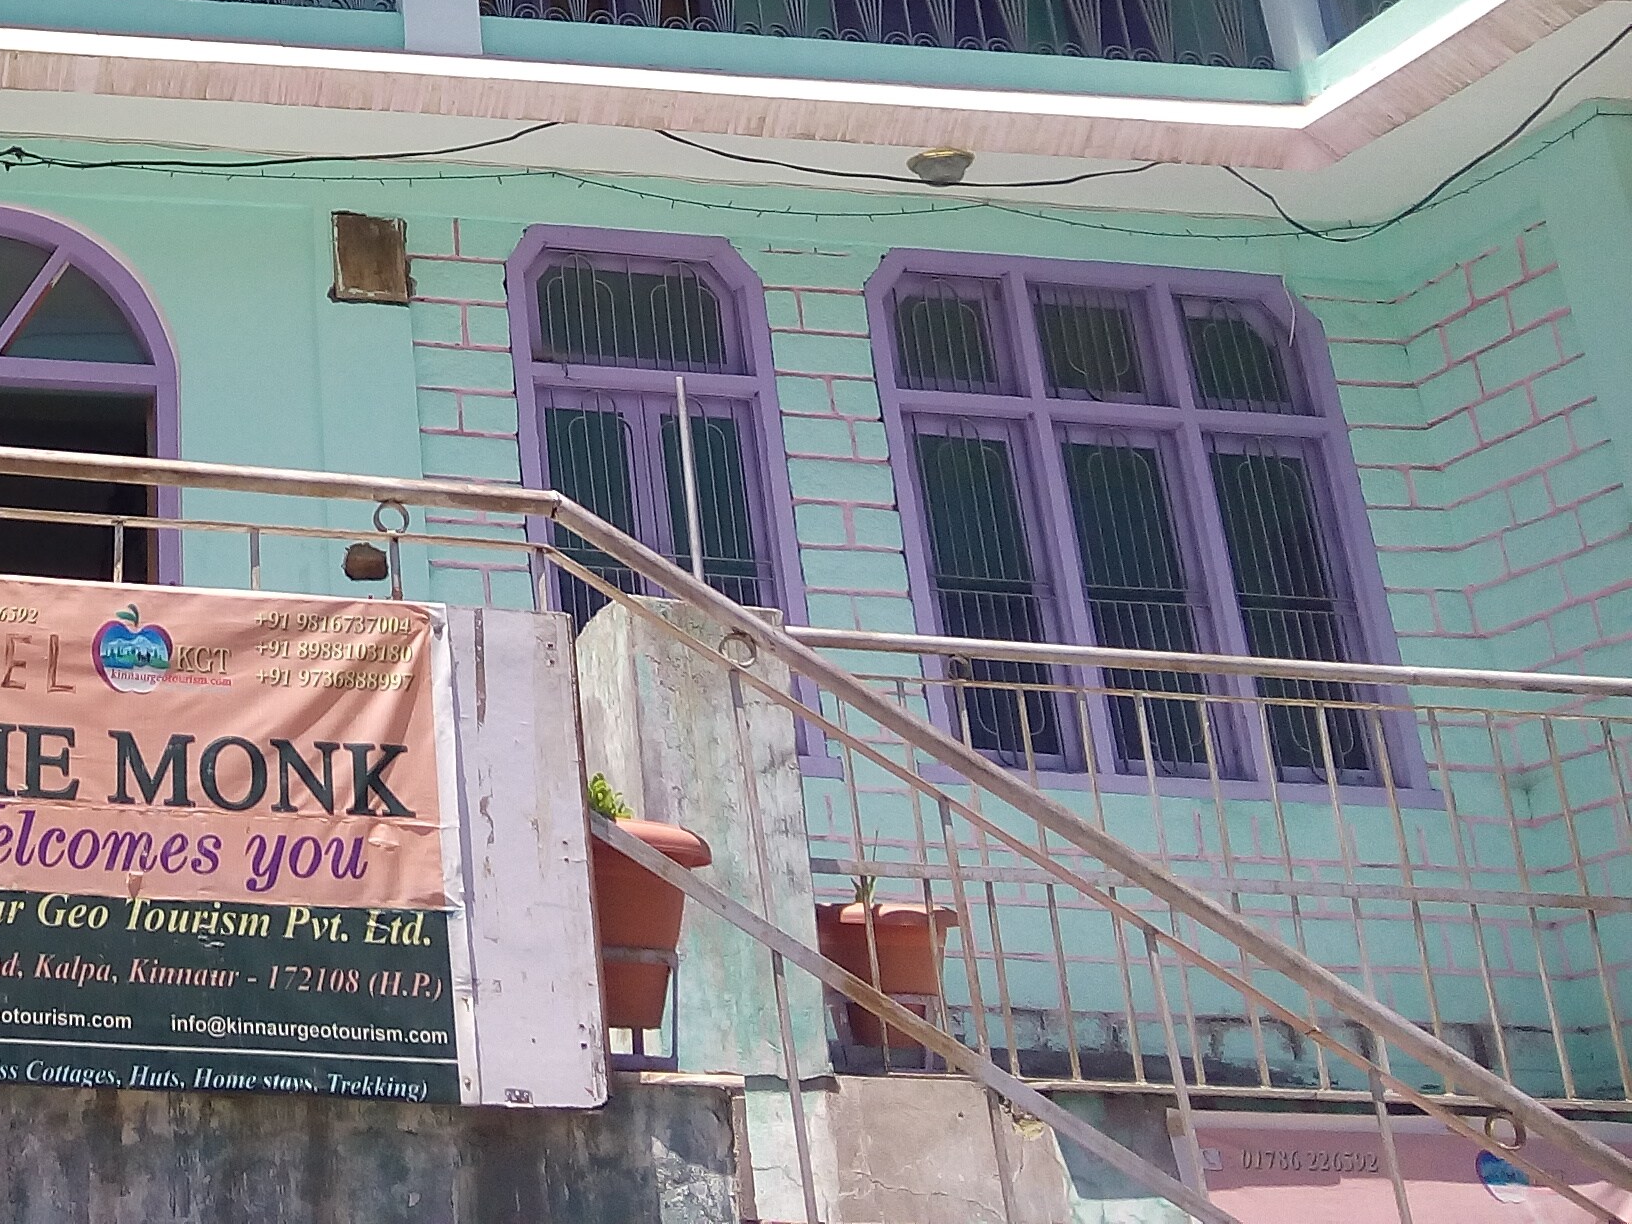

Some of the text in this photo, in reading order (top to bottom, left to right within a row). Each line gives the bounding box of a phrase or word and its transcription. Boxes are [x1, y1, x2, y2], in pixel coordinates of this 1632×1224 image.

[254, 612, 412, 636] +91 9816737004
[176, 645, 232, 674] KGT
[254, 639, 413, 663] +91 8988103180
[255, 666, 414, 691] +91 9736888997
[107, 730, 416, 819] MONK
[245, 830, 369, 892] you
[37, 892, 109, 929] Geo
[125, 897, 270, 938] Tourism
[282, 906, 350, 942] Pvt.
[364, 908, 431, 946] Ltd.
[34, 952, 118, 987] Kalpa,
[129, 957, 240, 988] Kinnaur
[269, 965, 360, 994] 172108
[368, 970, 443, 1003] (H.P.)
[171, 1014, 448, 1045] info@kinnaurgeotourism.com
[26, 1060, 121, 1087] Cottages,
[129, 1064, 185, 1089] Huts,
[193, 1067, 257, 1089] Home
[327, 1073, 428, 1102] Trekking)
[1241, 1148, 1303, 1171] 01786
